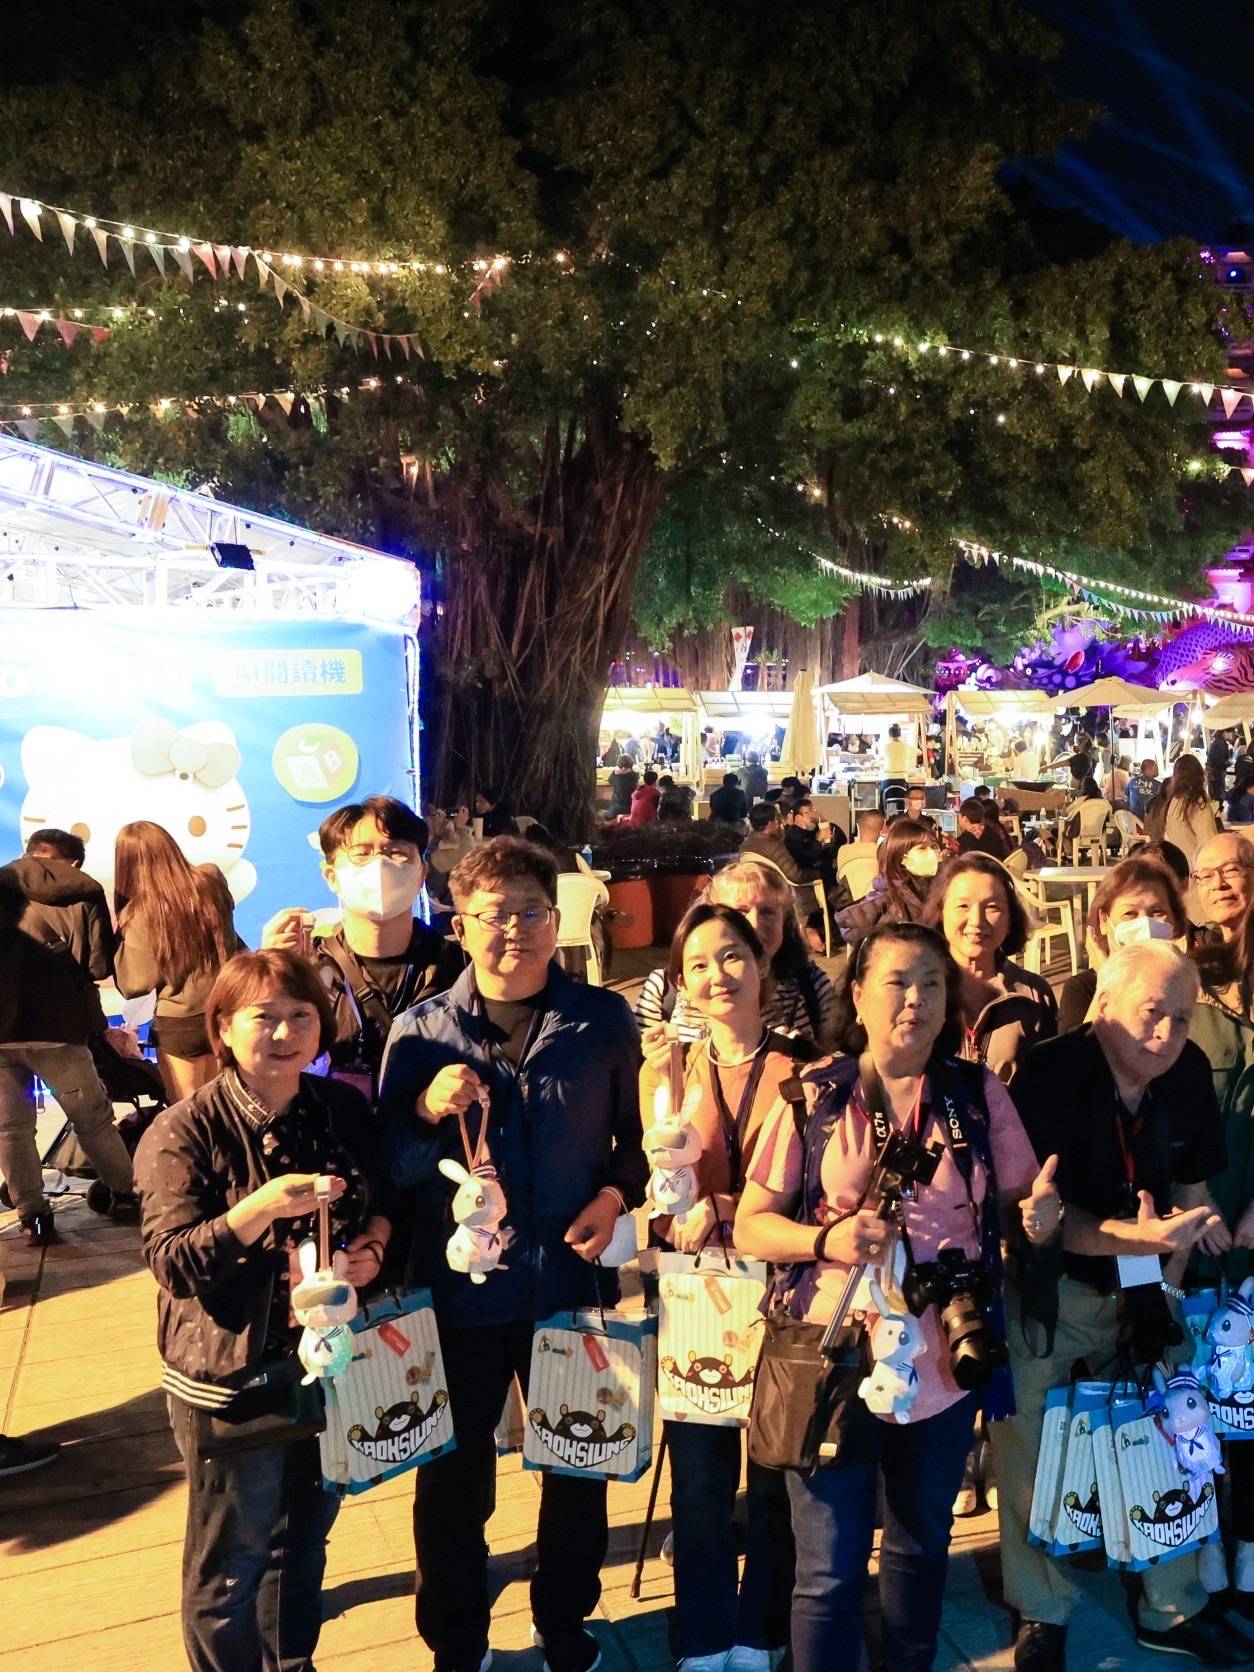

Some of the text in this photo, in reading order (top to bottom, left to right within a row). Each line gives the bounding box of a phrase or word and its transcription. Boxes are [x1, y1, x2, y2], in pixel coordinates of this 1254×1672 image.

[944, 1095, 964, 1140] SONY
[664, 1368, 754, 1414] KAOHSIUN
[351, 1402, 446, 1462] KAOHSIUNG
[531, 1419, 633, 1467] KAOHSIUNG
[1134, 1494, 1213, 1547] KAOHSIUNG
